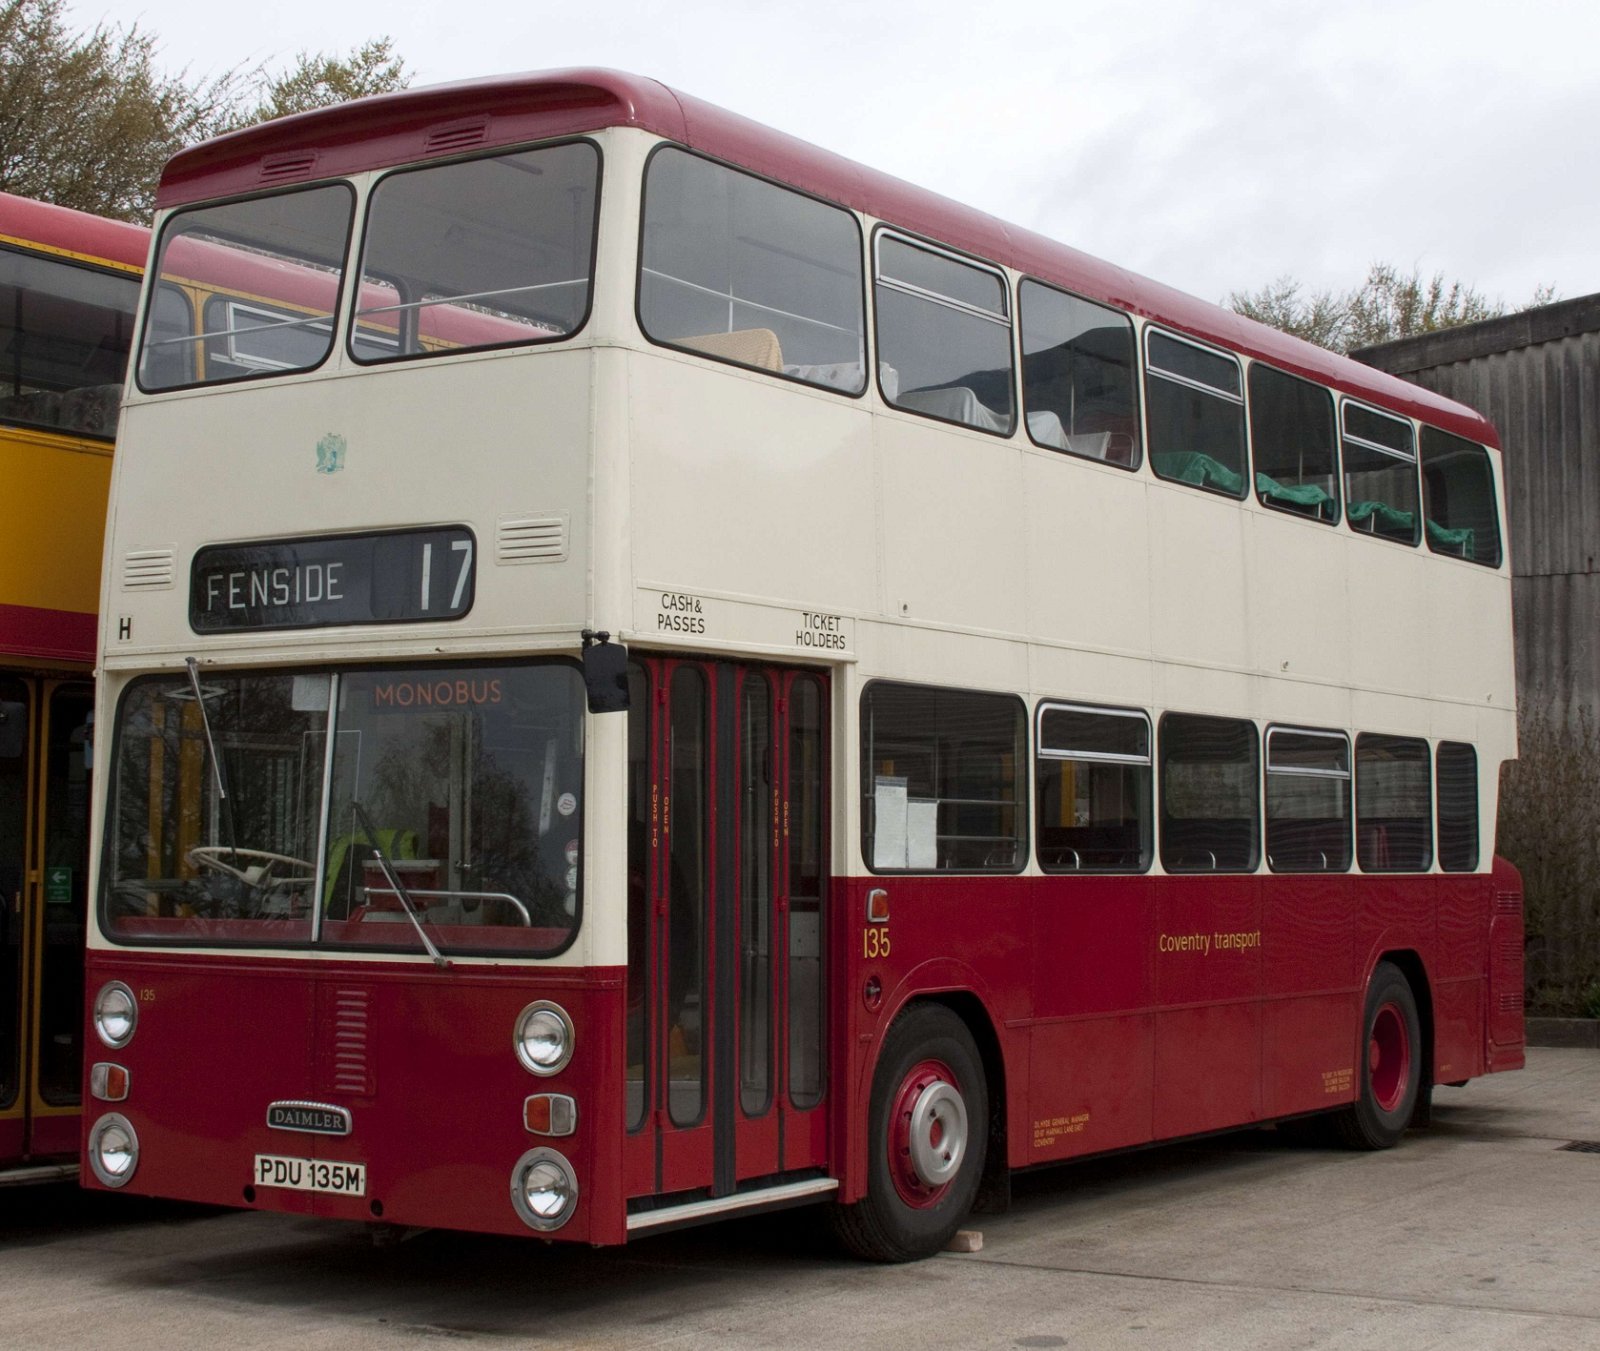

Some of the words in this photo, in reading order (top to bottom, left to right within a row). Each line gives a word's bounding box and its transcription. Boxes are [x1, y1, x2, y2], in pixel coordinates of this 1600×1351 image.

[206, 562, 344, 611] FENSIDE
[421, 540, 472, 610] 17
[119, 617, 132, 640] H
[657, 613, 705, 634] PASSES
[802, 612, 841, 632] TICKET
[795, 630, 846, 650] HOLDERS
[374, 679, 502, 706] MONOBUS
[652, 828, 659, 848] TO
[774, 829, 780, 847] TO
[863, 927, 891, 958] 135
[1160, 933, 1211, 956] Coventry
[1214, 929, 1261, 954] transport
[140, 989, 156, 1001] 135
[275, 1109, 343, 1129] DAIMLER
[260, 1158, 302, 1185] PDU
[309, 1163, 360, 1192] 135M
